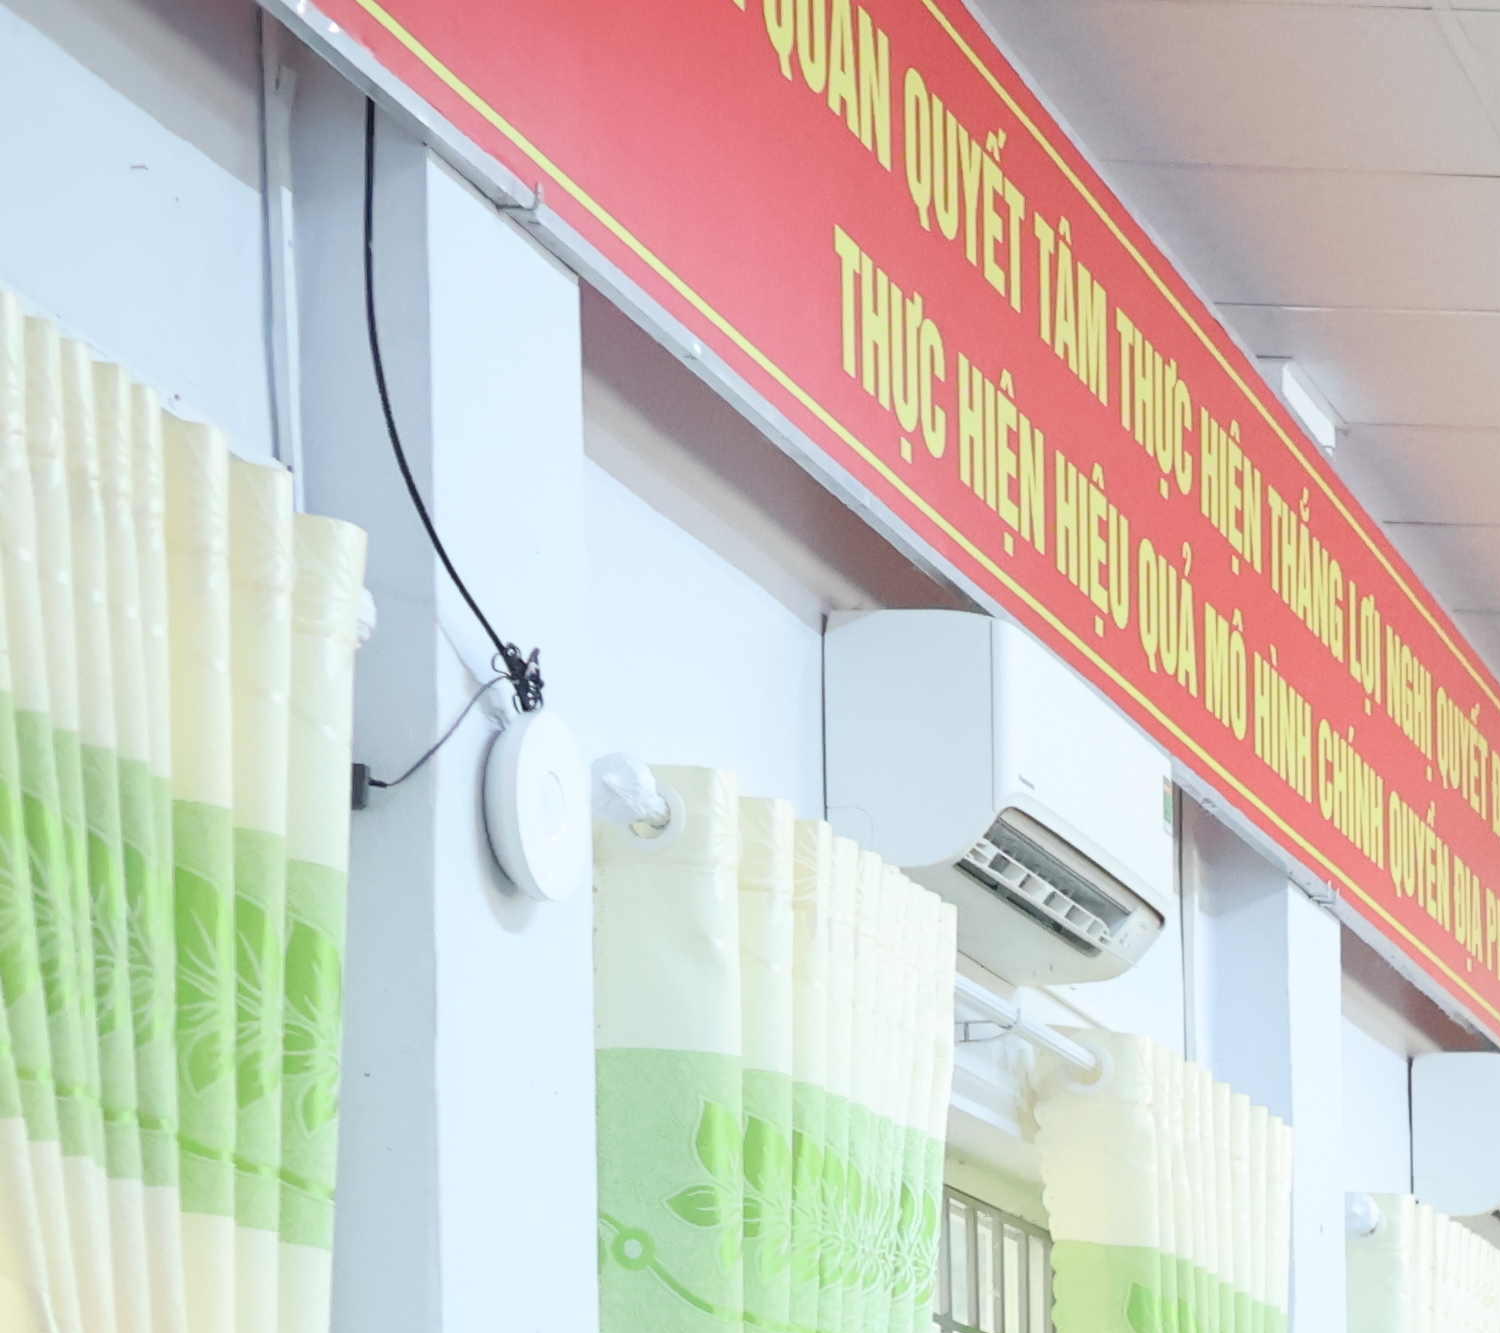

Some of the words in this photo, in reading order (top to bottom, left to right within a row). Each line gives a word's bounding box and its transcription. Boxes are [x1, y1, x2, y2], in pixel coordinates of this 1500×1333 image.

[834, 223, 947, 464] THỰC
[958, 351, 1045, 557] HIỆN
[1055, 449, 1130, 638] HIỆU
[1138, 538, 1198, 699] QUẢ
[1204, 602, 1247, 741] MÔ
[1254, 644, 1312, 804] HÌNH
[1318, 718, 1384, 870] CHÍNH
[1389, 790, 1451, 933] QUYỀN
[1453, 854, 1483, 972] ĐỊA
[904, 67, 1026, 313] QUYẾT
[1034, 212, 1108, 407] TÂM
[1116, 306, 1193, 499] THỰC
[1201, 406, 1262, 575] HIỆN
[1268, 485, 1344, 663] THẮNG
[1349, 580, 1381, 716] LỢI
[1386, 624, 1432, 782] NGHỊ
[1436, 686, 1489, 820] QUYẾT
